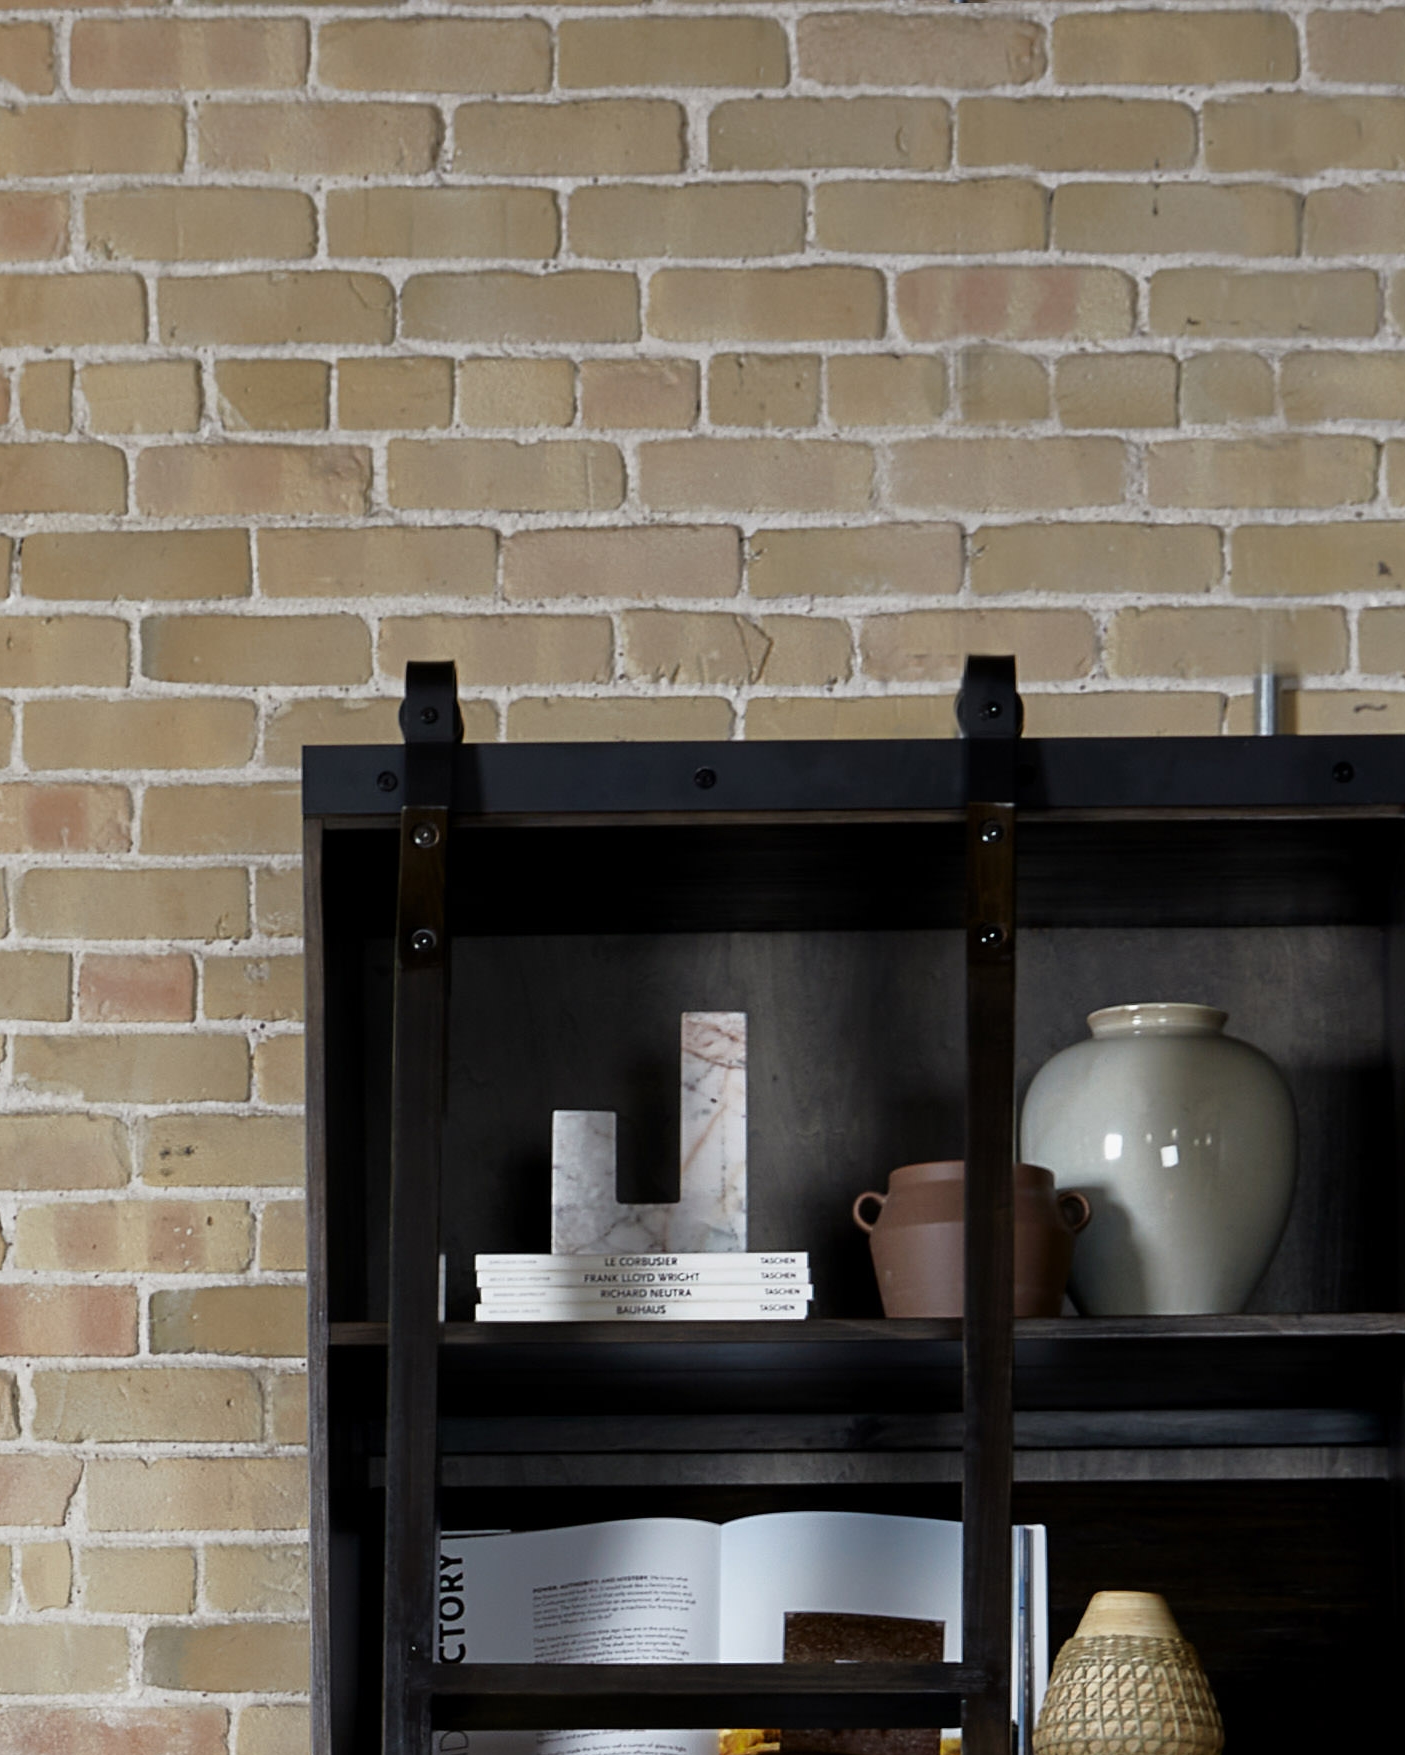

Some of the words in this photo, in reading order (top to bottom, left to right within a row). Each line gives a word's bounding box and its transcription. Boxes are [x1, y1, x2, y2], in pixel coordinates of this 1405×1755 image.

[604, 1257, 616, 1267] LE
[619, 1256, 679, 1267] CORBUSIER
[583, 1272, 618, 1283] FRANK
[621, 1272, 656, 1283] LLOYD
[658, 1272, 700, 1282] WRIGHT
[600, 1288, 647, 1298] RICHARD
[650, 1288, 692, 1298] NEUTRA
[616, 1304, 667, 1315] BAUHAUS
[439, 1554, 467, 1664] CTORY
